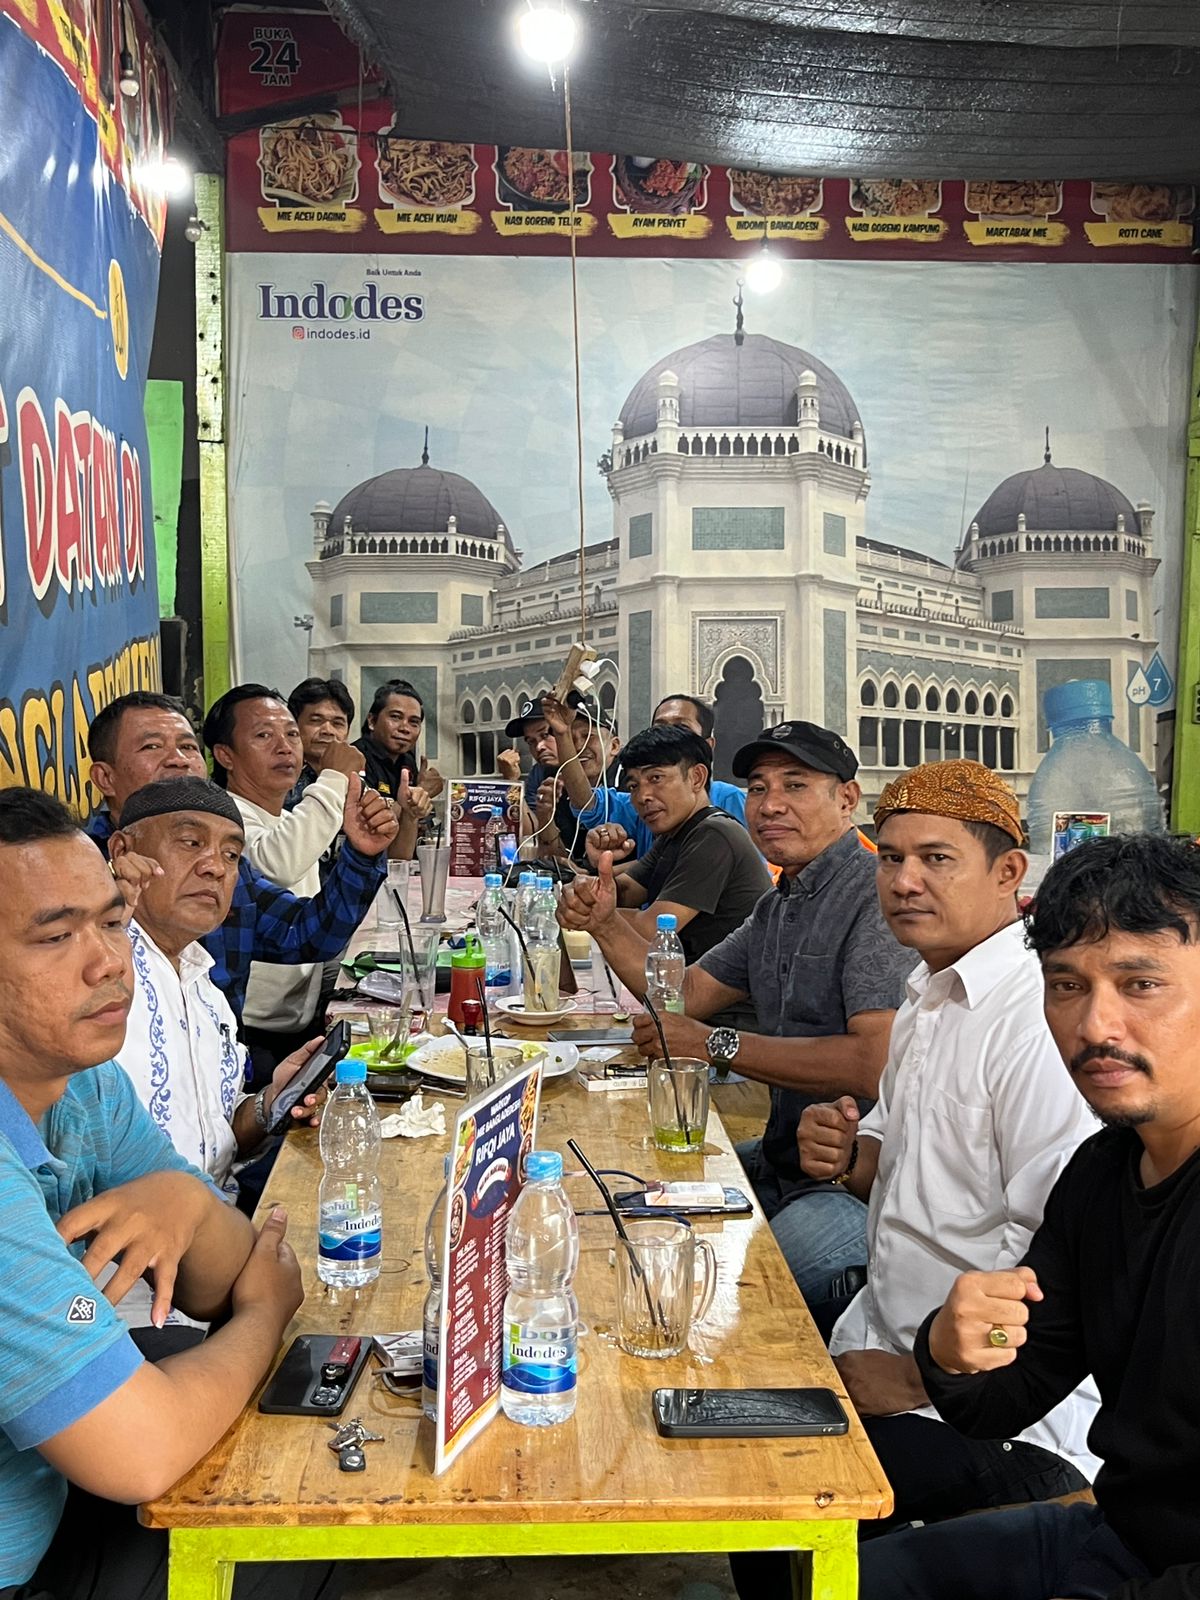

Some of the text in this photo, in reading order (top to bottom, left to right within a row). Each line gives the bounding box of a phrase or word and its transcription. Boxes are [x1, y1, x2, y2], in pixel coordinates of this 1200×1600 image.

[253, 28, 293, 40] BUKA
[249, 40, 301, 74] 24
[262, 74, 291, 86] JAM
[277, 211, 347, 222] MIE ACEH DAGING
[396, 213, 458, 223] MIE ACEH KUAH
[504, 216, 522, 226] NASI
[525, 217, 557, 226] GORENG
[632, 218, 687, 228] AYAM PENYET
[770, 221, 819, 231] BANGLADESH
[852, 223, 940, 233] NASI GORENG KAMPUNG
[985, 227, 1048, 238] MARTABAK MIE
[1118, 228, 1164, 238] ROTI CANE
[257, 283, 424, 320] Indodes
[306, 328, 371, 340] indodes.id
[120, 440, 144, 583] DI
[1153, 678, 1162, 691] 7
[1132, 686, 1146, 696] pH
[475, 1122, 515, 1166] RIFQI JAYA
[512, 1343, 566, 1359] Indodes
